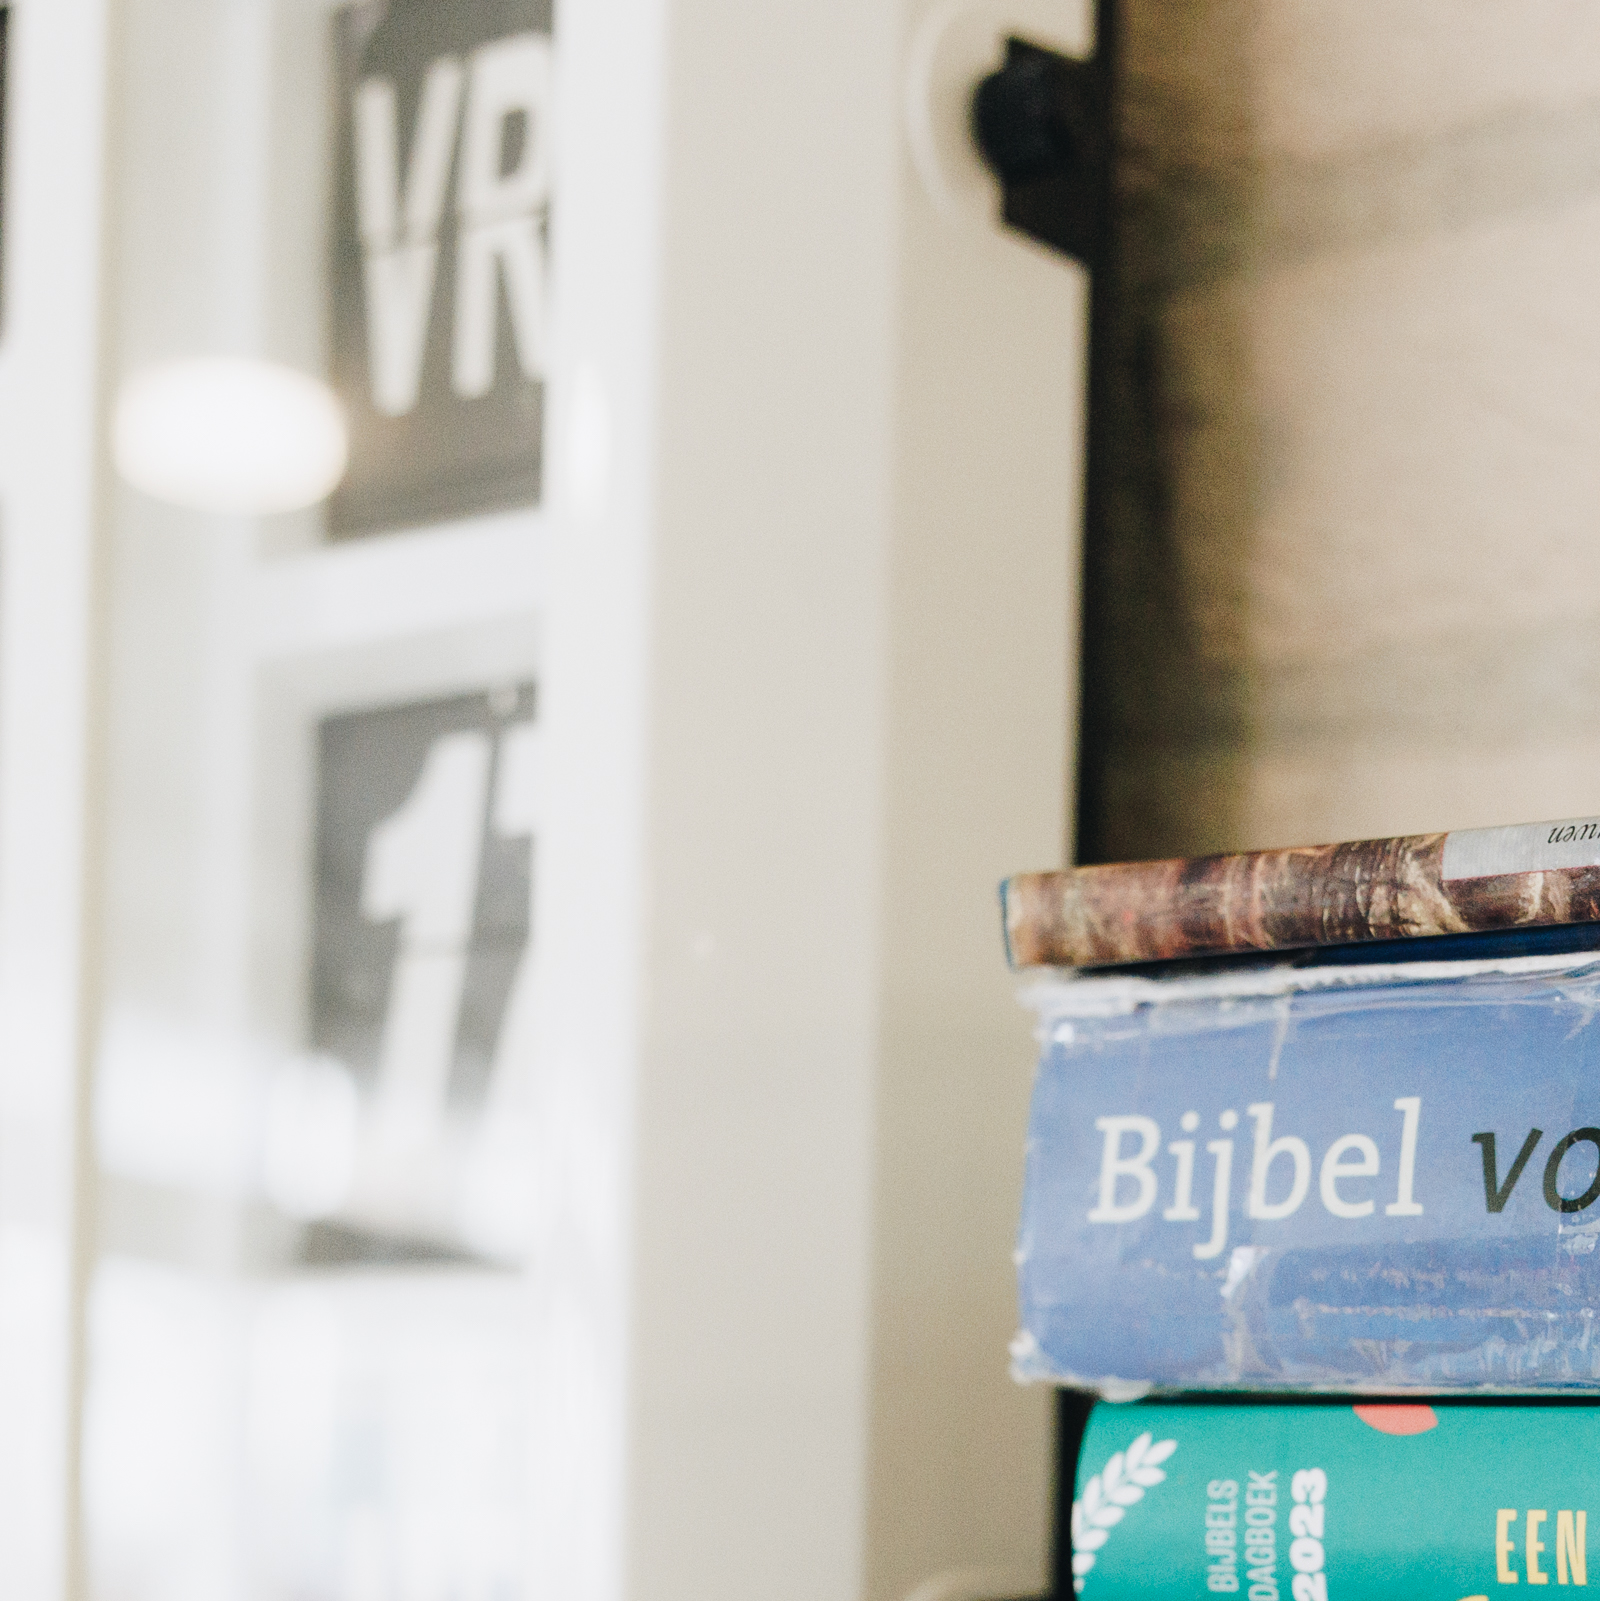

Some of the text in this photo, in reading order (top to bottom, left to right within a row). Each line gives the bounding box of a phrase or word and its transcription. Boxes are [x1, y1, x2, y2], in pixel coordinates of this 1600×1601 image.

[1087, 1097, 1425, 1259] Bijbel
[1205, 1477, 1240, 1593] BIJBELS
[1495, 1508, 1588, 1586] EEN
